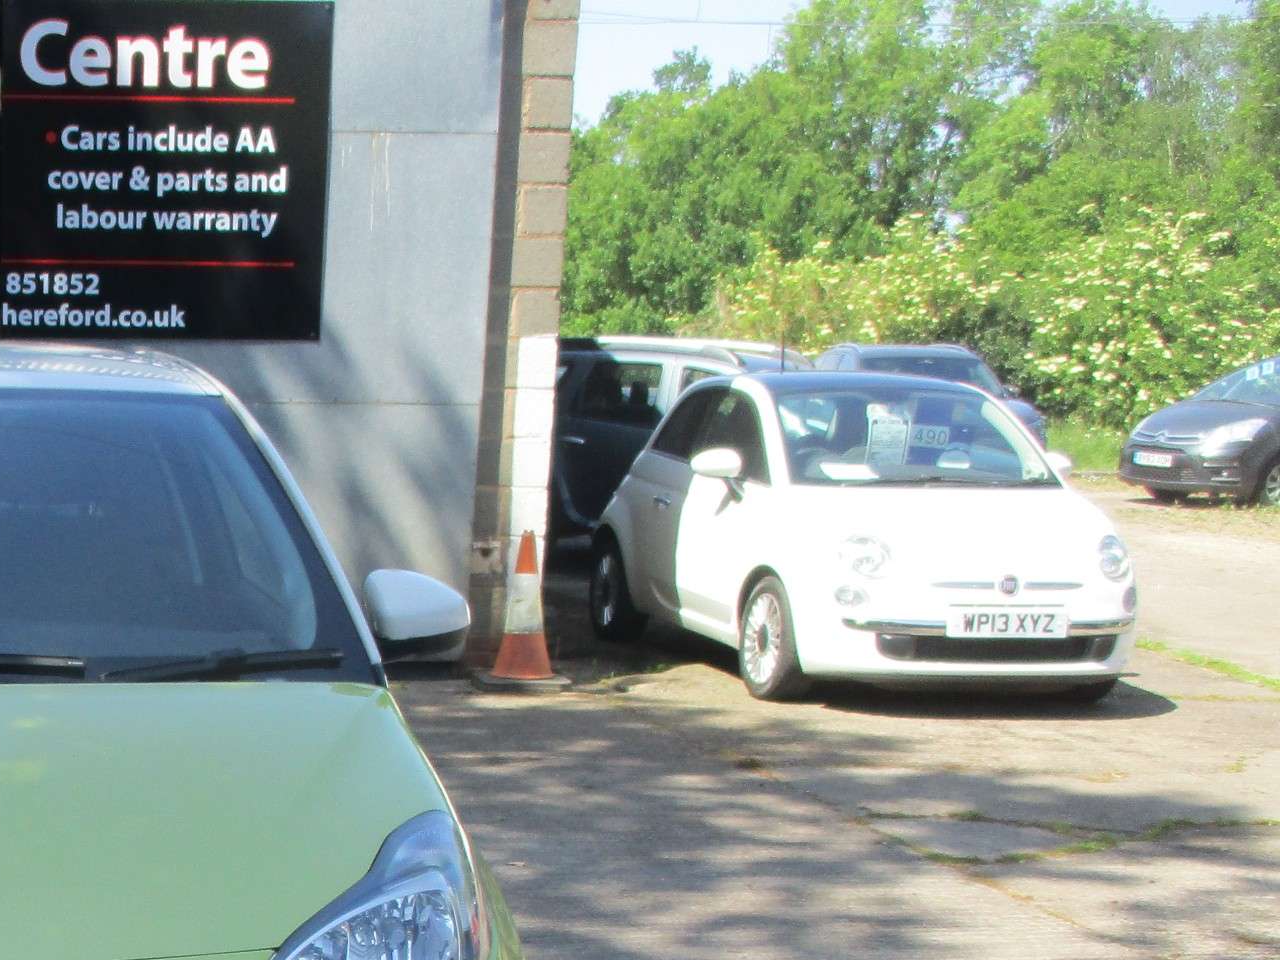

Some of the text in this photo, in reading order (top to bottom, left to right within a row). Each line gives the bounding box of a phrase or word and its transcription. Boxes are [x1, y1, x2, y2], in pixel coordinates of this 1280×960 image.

[20, 19, 272, 91] Centre
[60, 124, 277, 154] Cars include AA
[47, 165, 289, 197] cover & parts and
[56, 203, 278, 238] labour warranty
[6, 272, 100, 295] 851852
[963, 613, 1056, 633] WP13 XYZ
